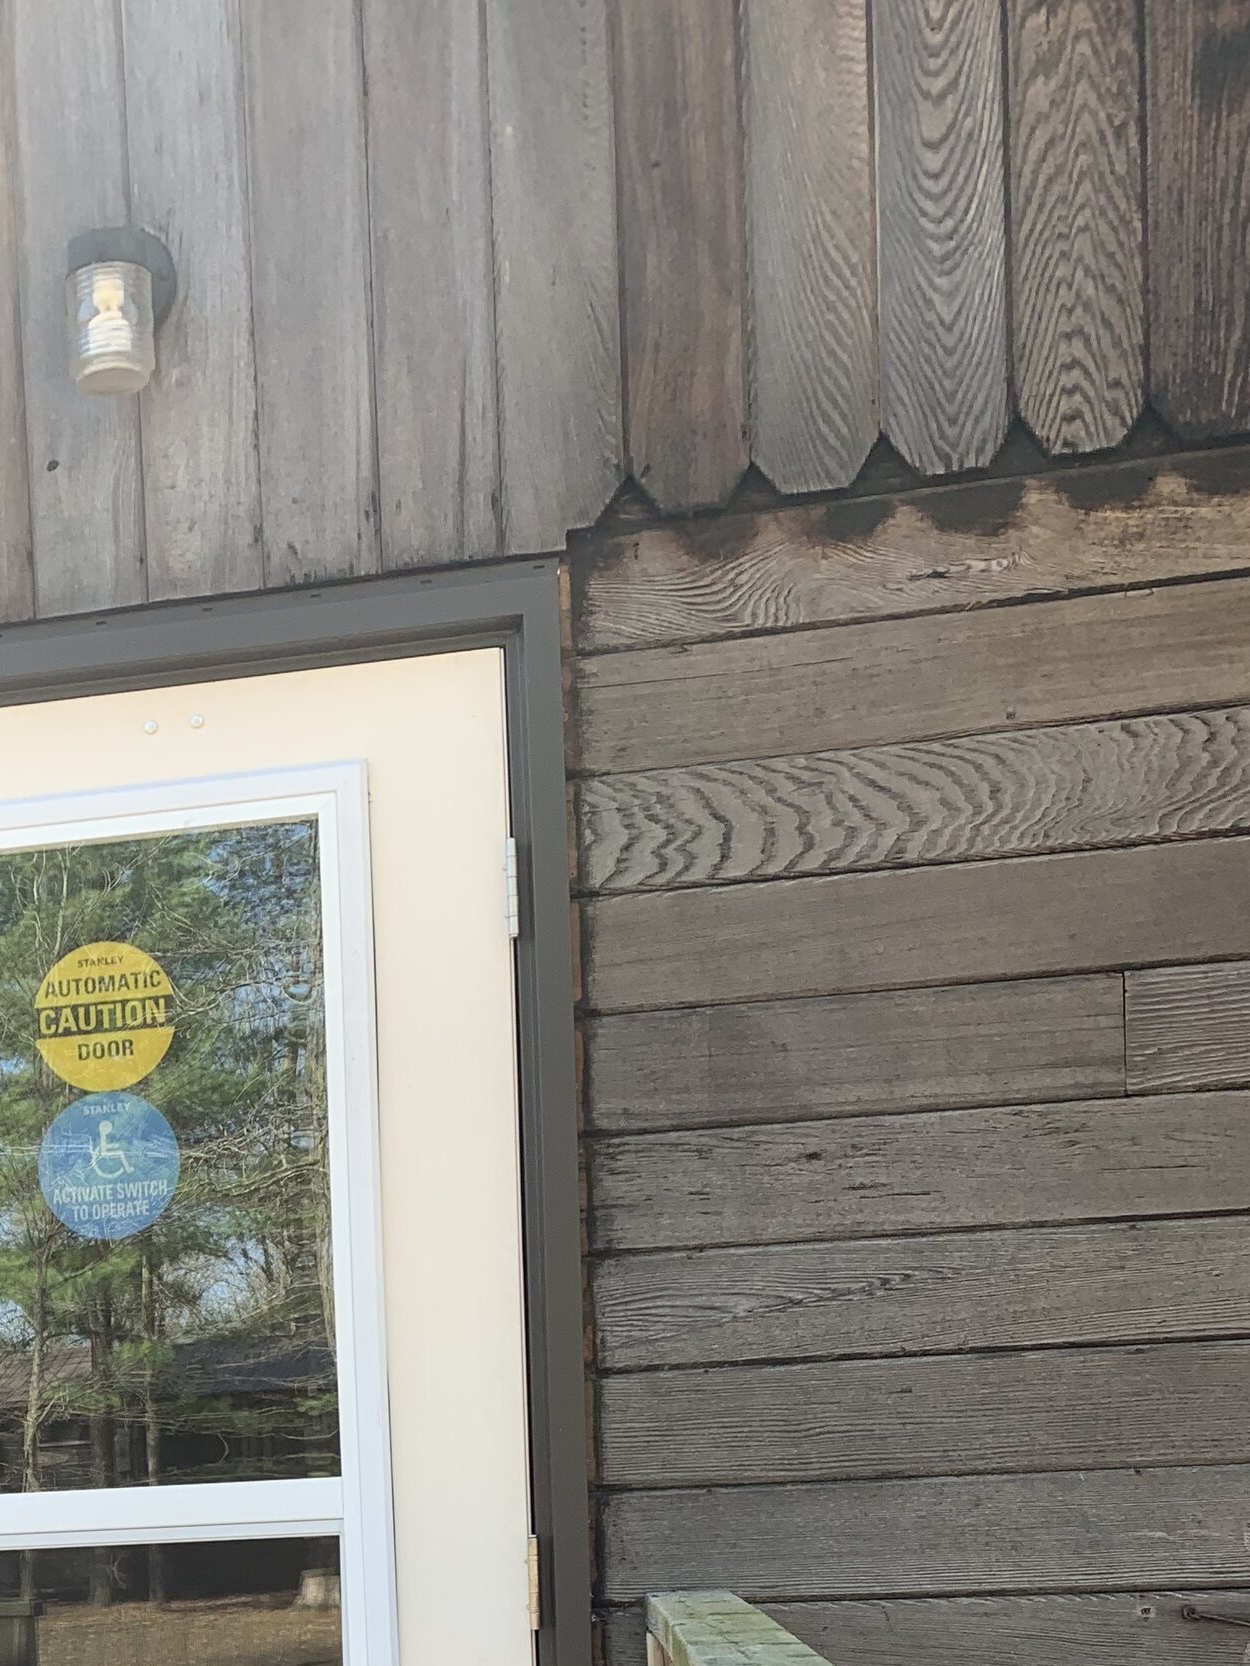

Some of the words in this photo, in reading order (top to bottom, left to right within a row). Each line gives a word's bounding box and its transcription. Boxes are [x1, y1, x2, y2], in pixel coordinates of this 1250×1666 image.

[77, 955, 125, 968] STANLEY
[44, 969, 161, 999] AUTOMATIC
[39, 997, 166, 1036] CAUTION
[77, 1038, 134, 1061] DOOR
[83, 1102, 131, 1115] STANLEY
[53, 1183, 113, 1205] ACTIVATE
[117, 1179, 168, 1199] SWITCH
[71, 1205, 88, 1222] TO
[92, 1200, 150, 1220] OPERATE
